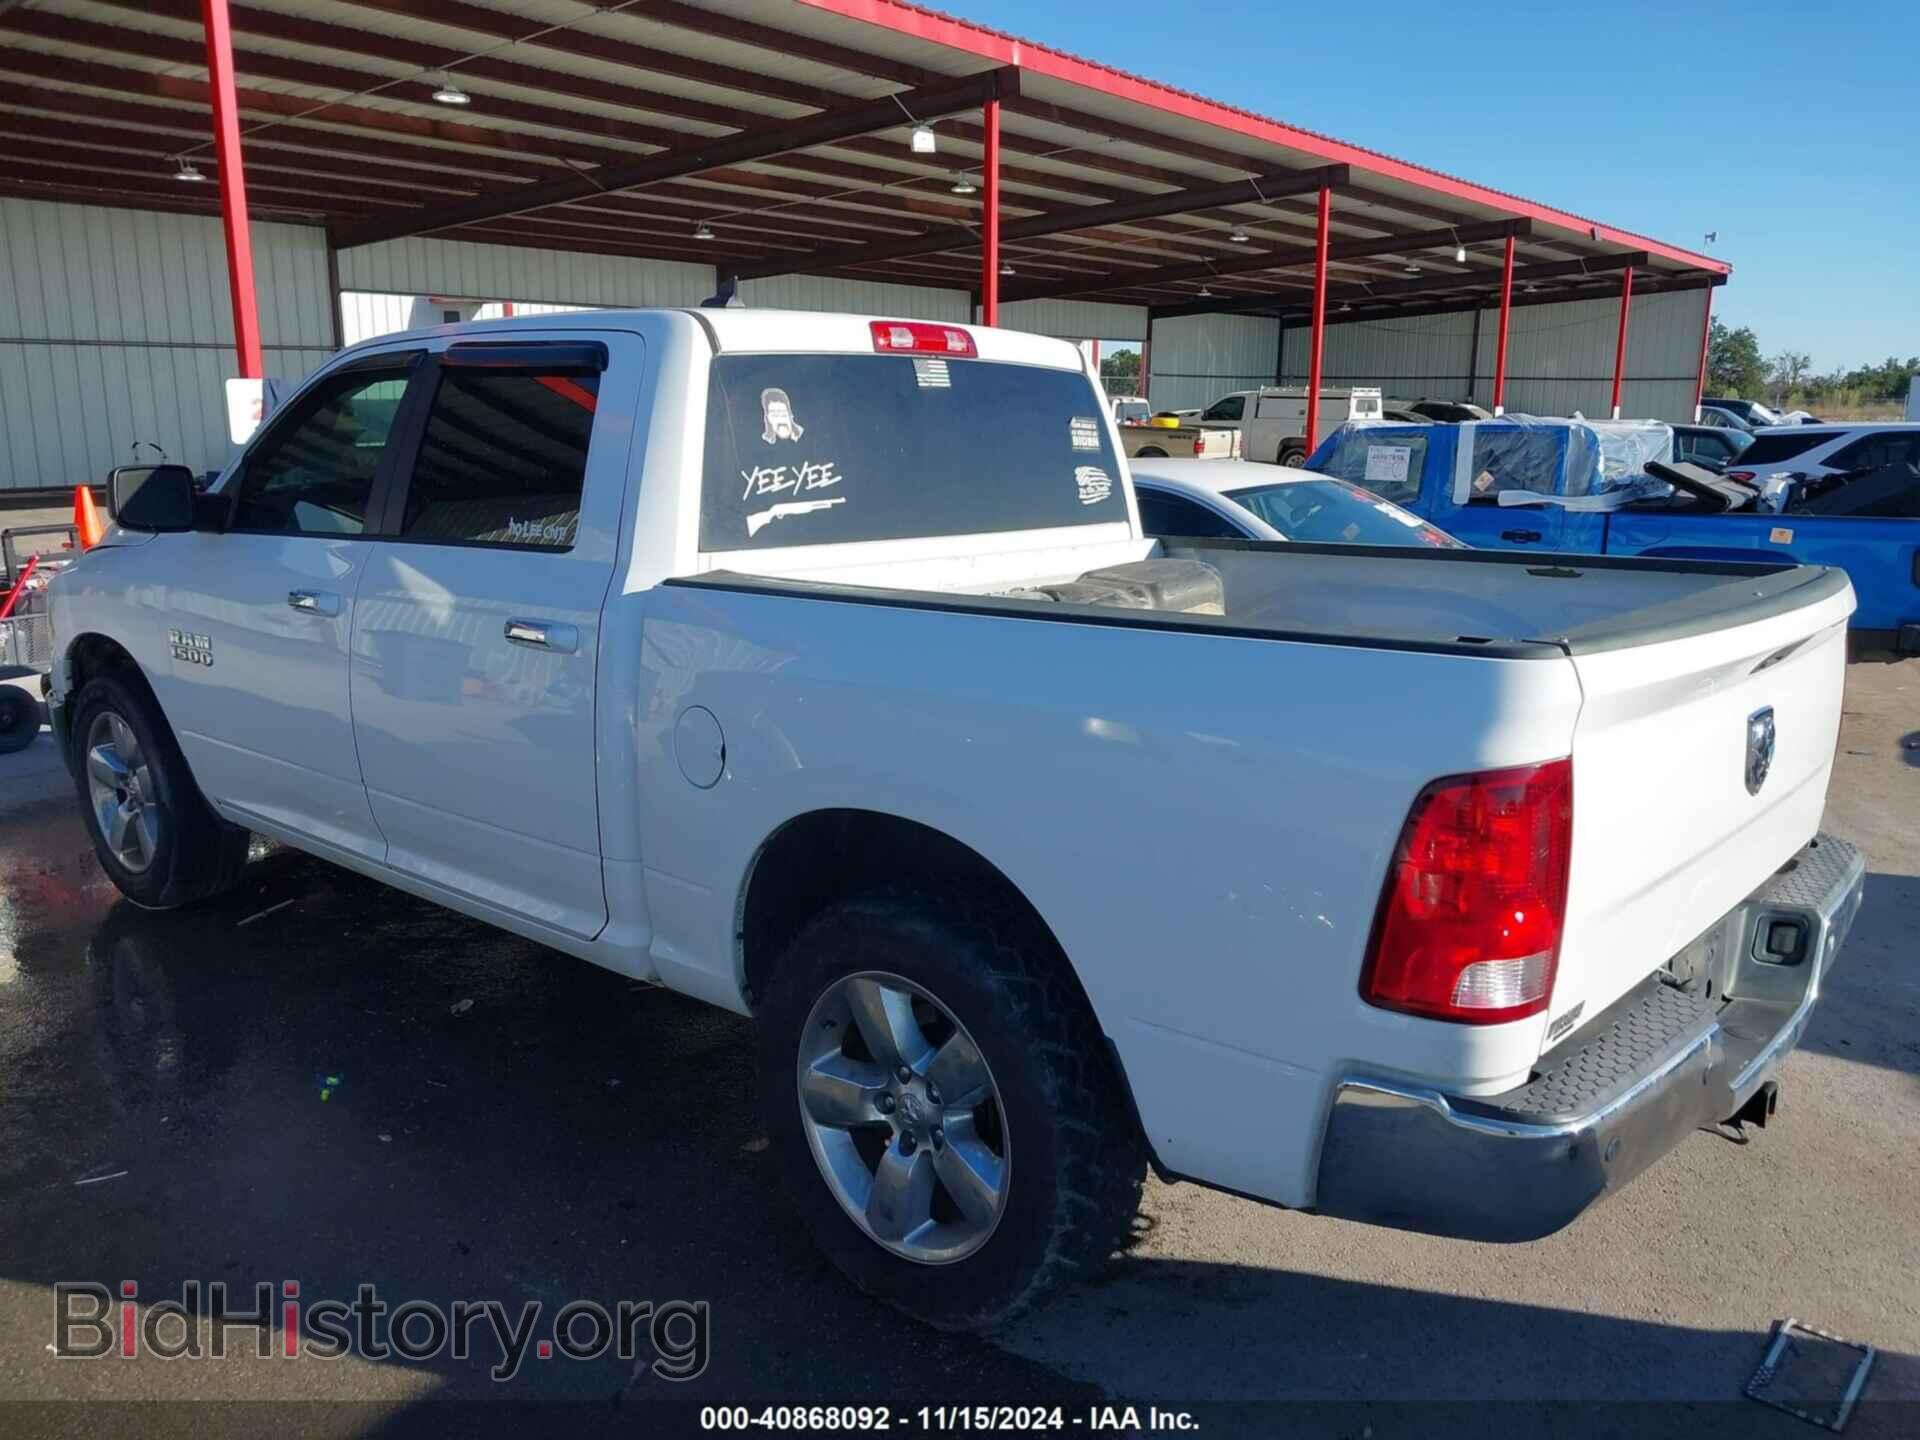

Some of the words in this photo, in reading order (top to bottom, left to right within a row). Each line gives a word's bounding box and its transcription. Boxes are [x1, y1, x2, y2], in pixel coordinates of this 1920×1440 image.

[740, 465, 796, 501] YEE
[791, 460, 843, 497] YEE
[168, 629, 211, 650] RAM
[170, 646, 214, 667] 1500
